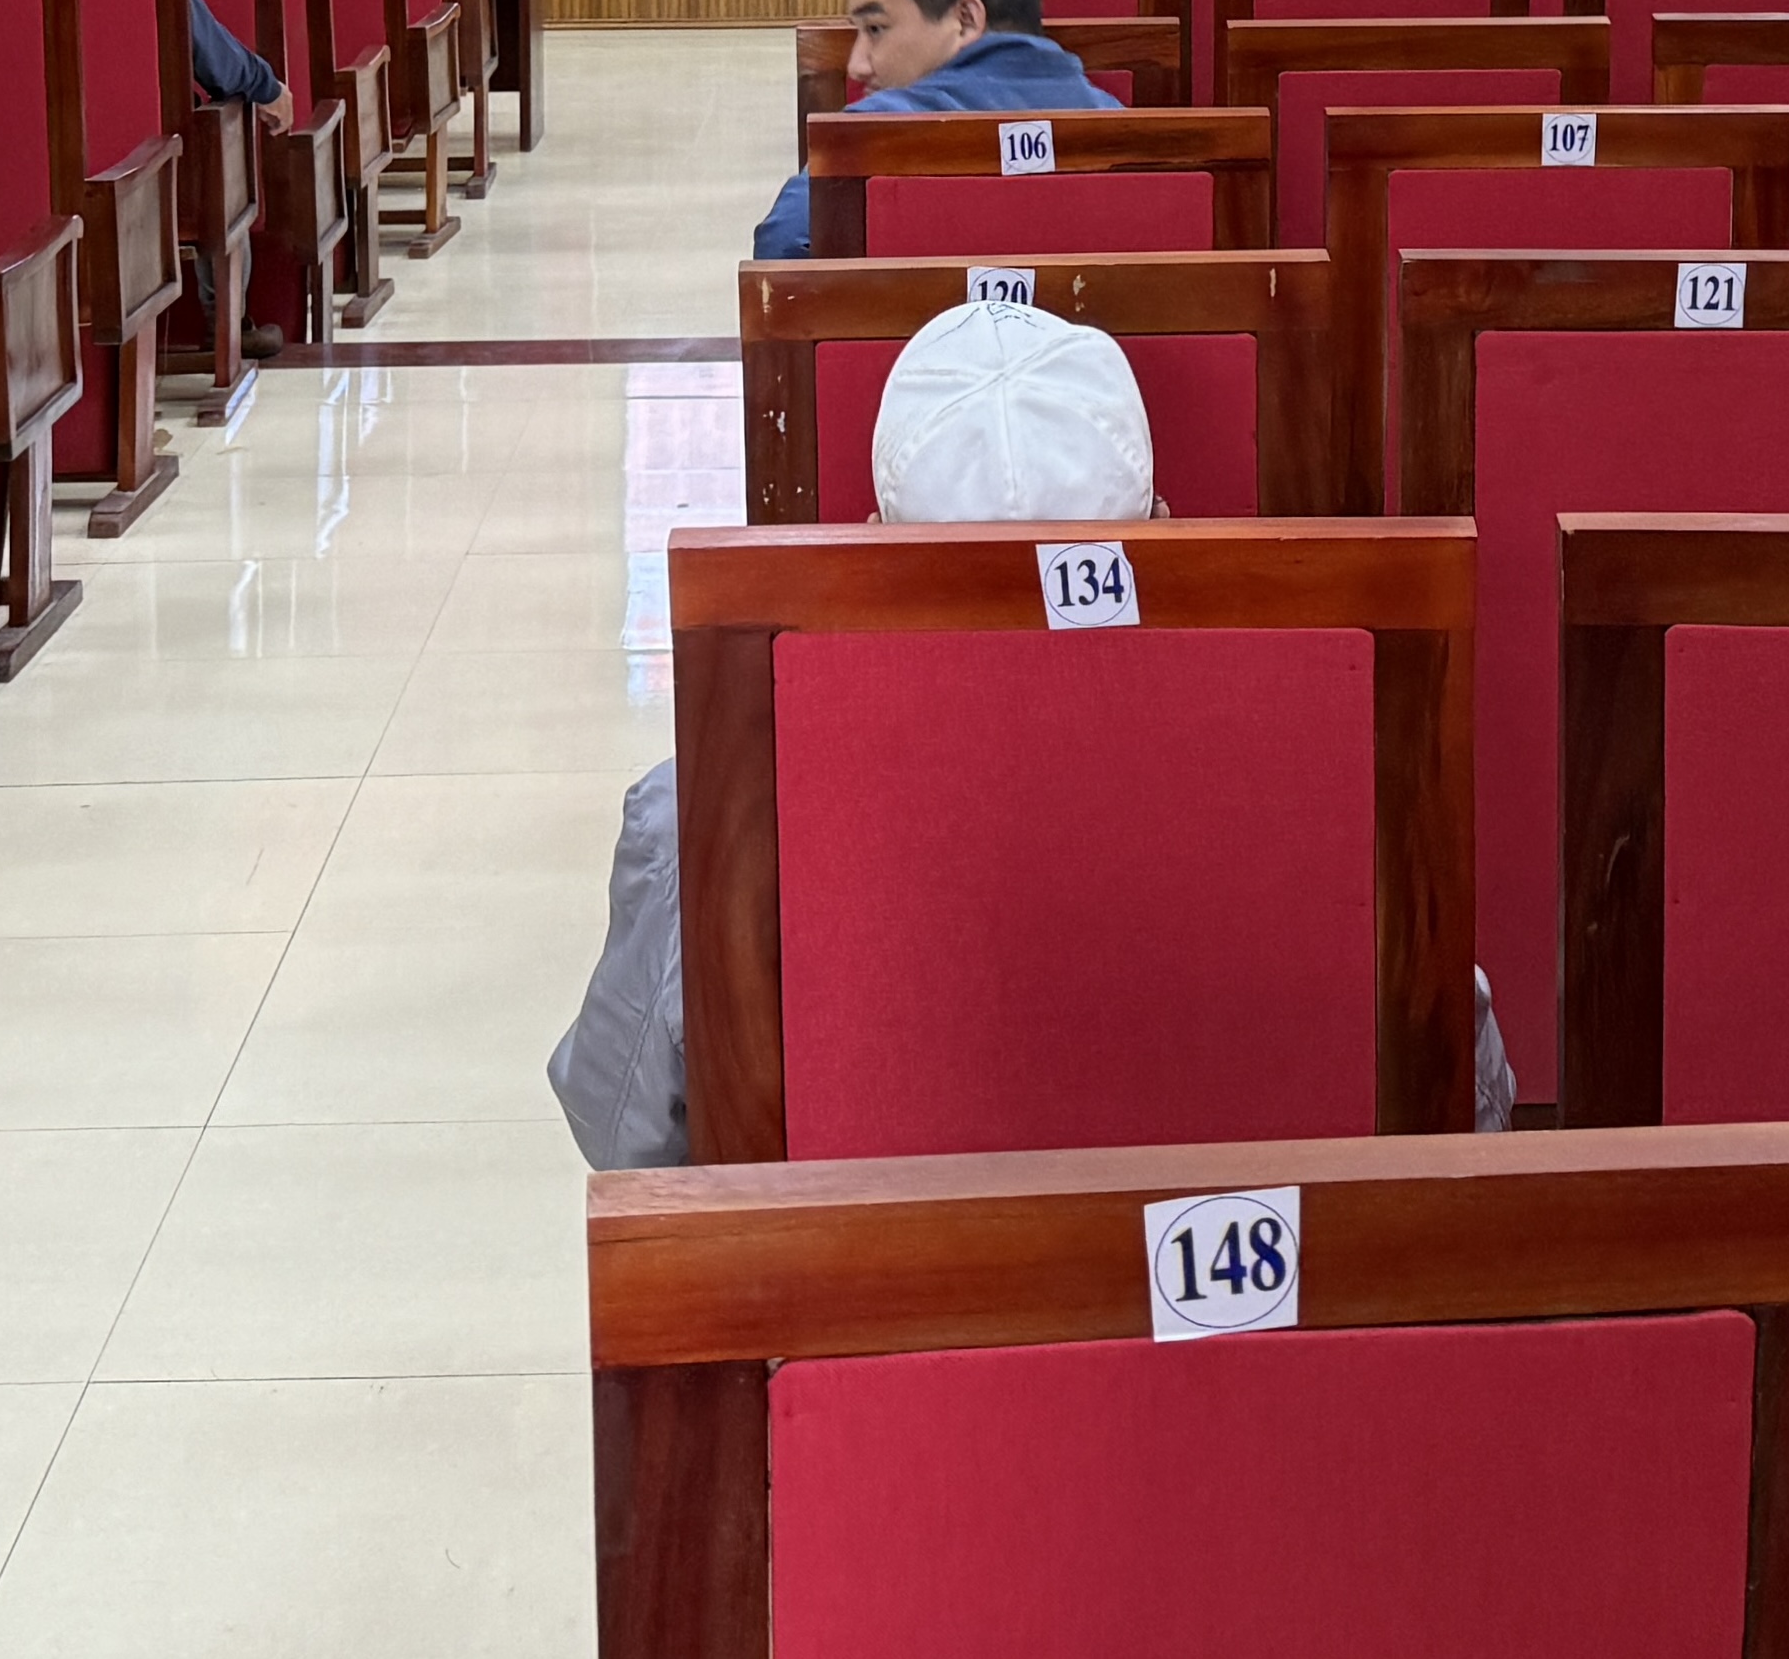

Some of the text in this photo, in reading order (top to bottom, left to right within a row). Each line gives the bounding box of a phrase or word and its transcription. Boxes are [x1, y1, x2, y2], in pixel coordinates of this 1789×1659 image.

[1008, 130, 1047, 162] 106
[1550, 123, 1590, 152] 107
[1688, 275, 1735, 311] 121
[1053, 556, 1125, 608] 134
[1171, 1217, 1286, 1302] 148
